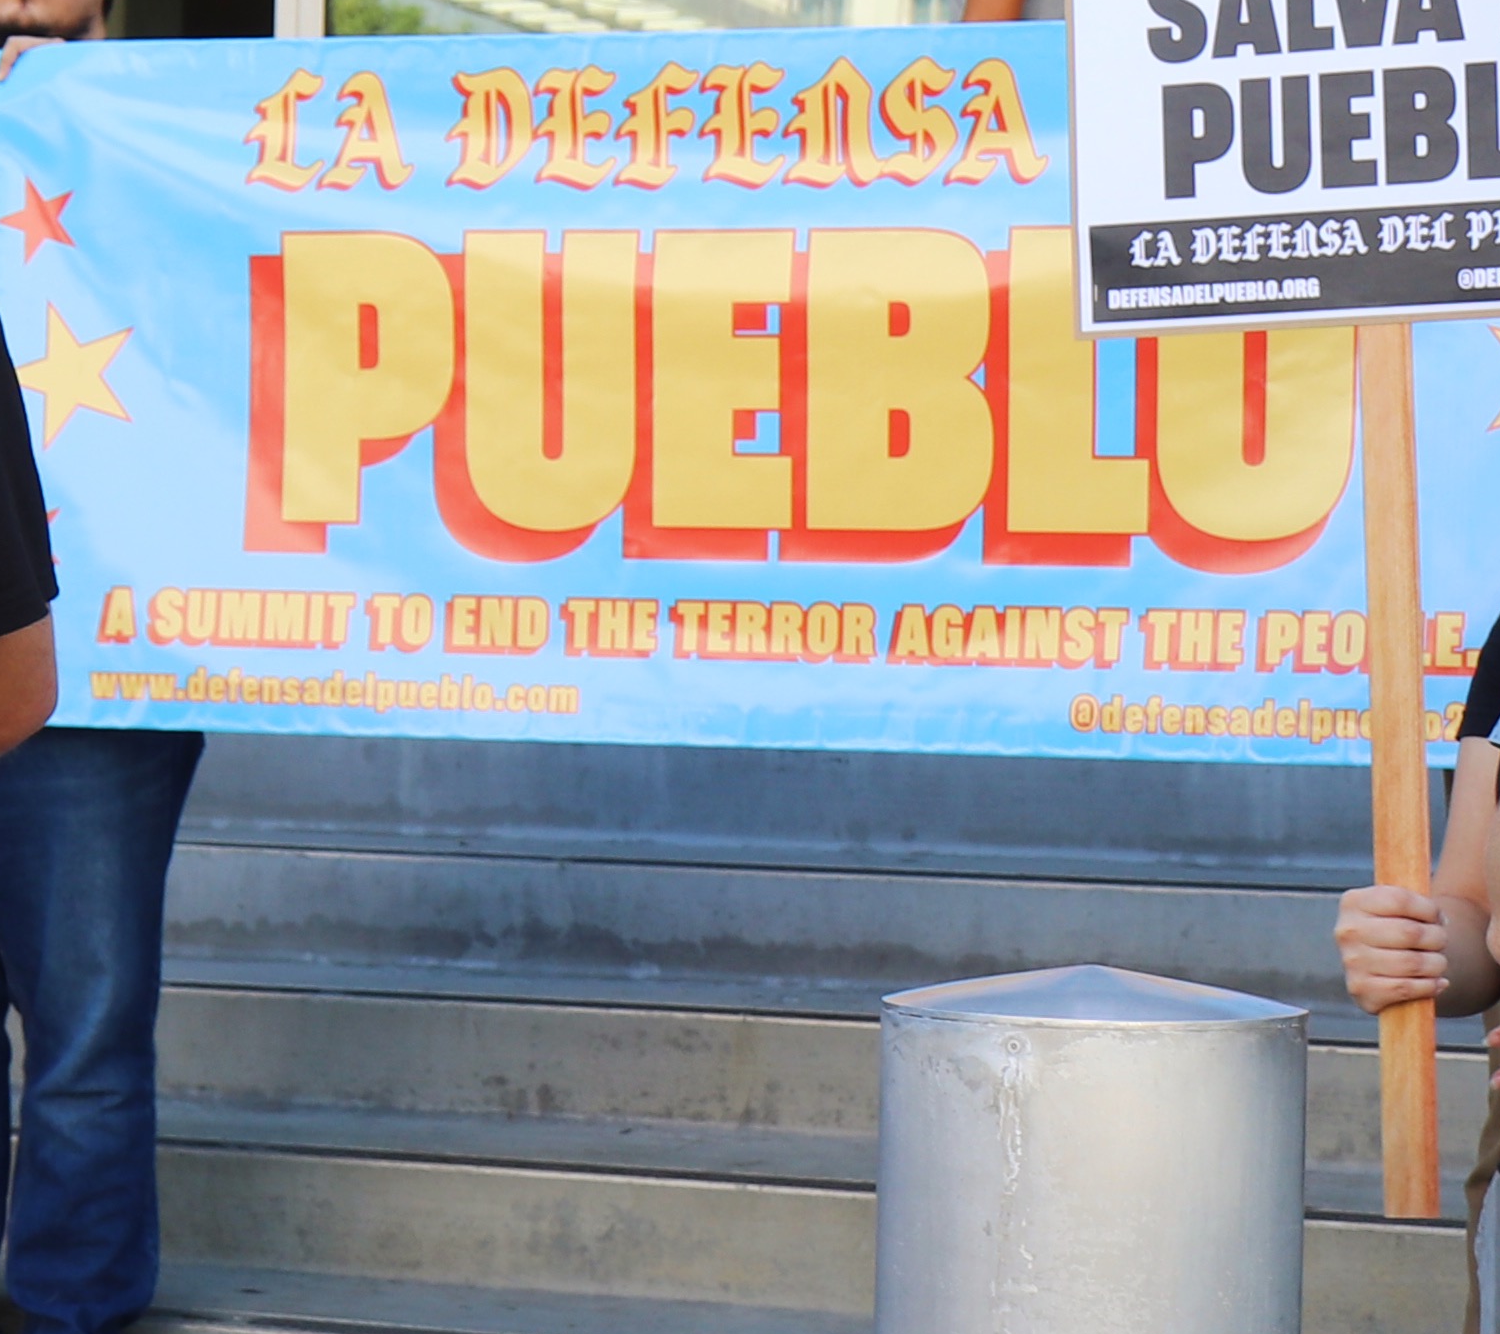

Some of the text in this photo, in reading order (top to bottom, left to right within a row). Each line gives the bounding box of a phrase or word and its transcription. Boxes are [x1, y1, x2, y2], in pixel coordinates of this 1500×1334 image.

[244, 55, 1050, 191] LA DEFENSA
[1130, 229, 1183, 269] LA
[1191, 216, 1369, 264] DEFENSA
[1378, 209, 1457, 255] DEL
[1108, 277, 1321, 310] DEFENSADELPUEBLO.ORG
[245, 225, 1360, 575] PUEBLO
[97, 585, 1480, 675] A SUMMIT TO END THE TERROR AGAINST THE PEOE.
[89, 666, 580, 714] www.defensadelpueblo.com
